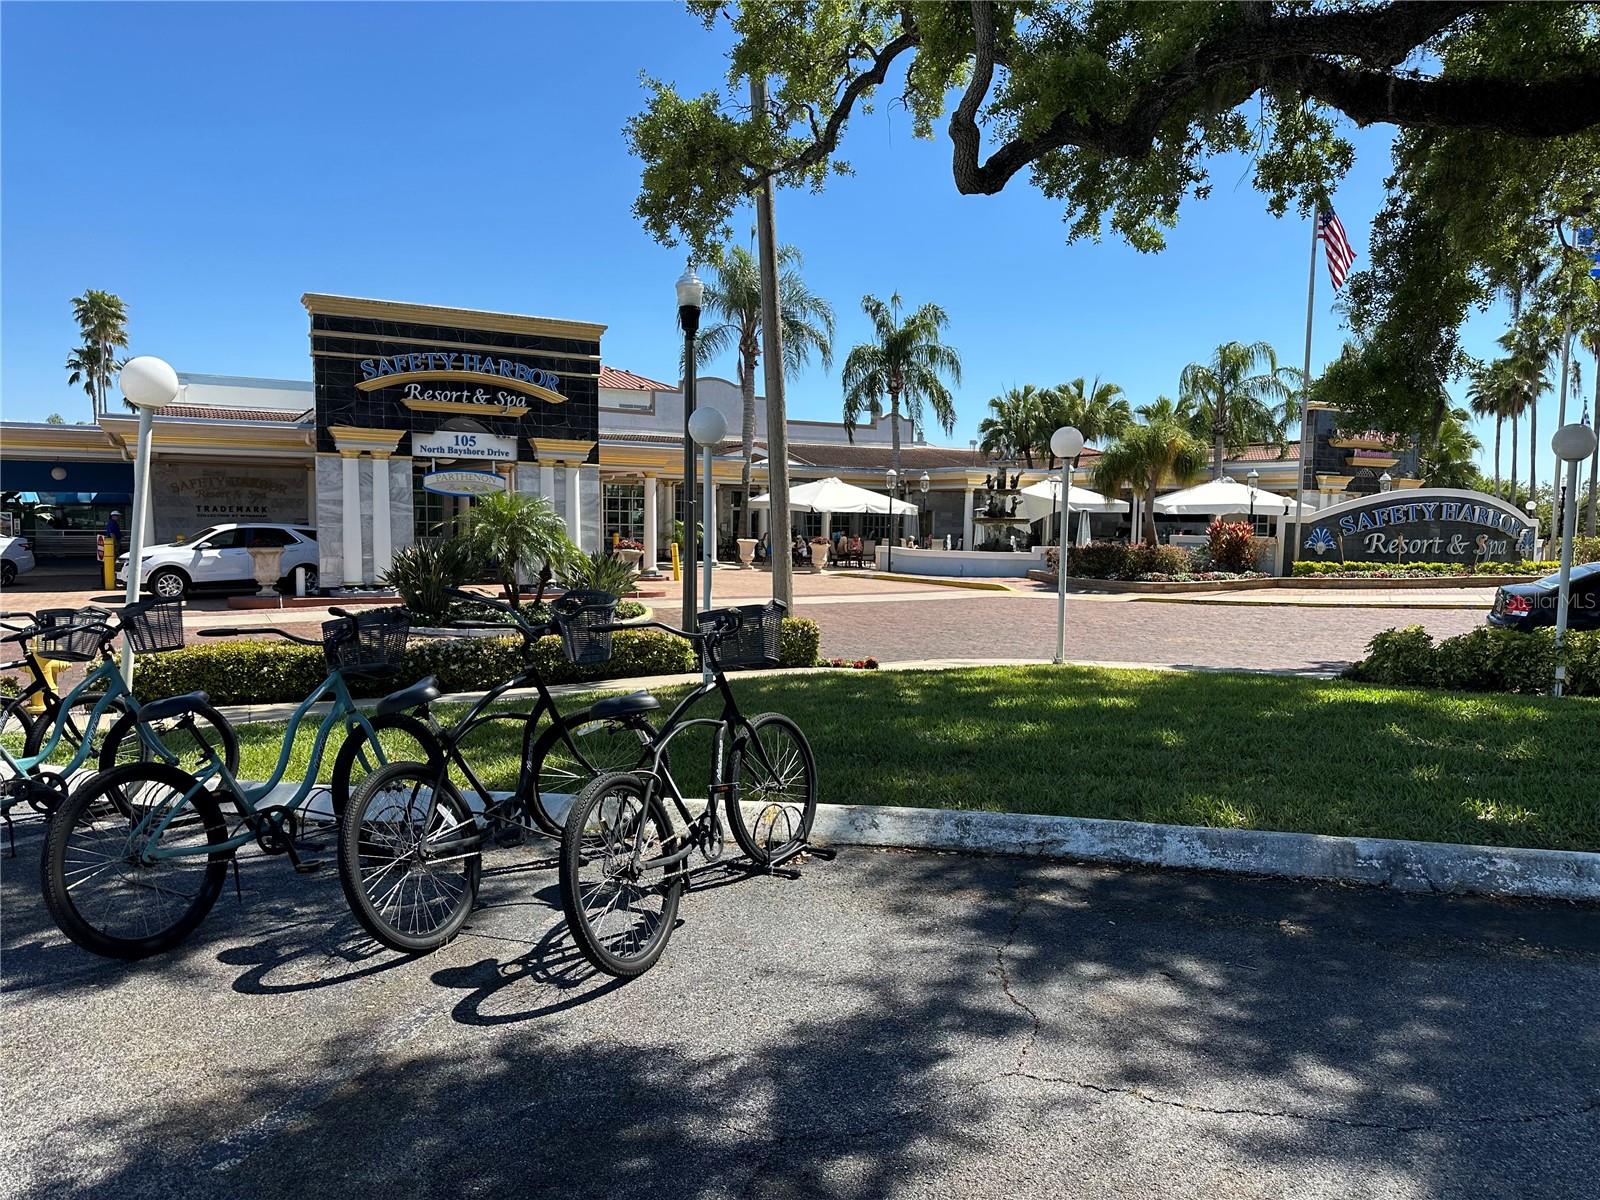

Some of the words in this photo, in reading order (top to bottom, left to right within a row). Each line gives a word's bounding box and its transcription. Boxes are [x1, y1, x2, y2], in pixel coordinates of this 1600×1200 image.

[360, 352, 457, 380] SAFETY
[461, 353, 560, 393] HARBOR
[404, 383, 470, 403] Resort
[472, 388, 491, 404] &
[494, 391, 527, 415] Spa
[420, 445, 445, 454] North
[447, 446, 485, 456] Bayshore
[487, 448, 510, 457] Drive
[453, 434, 477, 447] 105
[435, 473, 497, 484] PARTHENON
[195, 504, 268, 513] TRADEMARK
[1339, 502, 1439, 536] SAFETY
[1441, 503, 1522, 539] HARBOR
[1364, 532, 1444, 554] Resort
[1445, 533, 1470, 555] &
[1473, 534, 1507, 561] Spa
